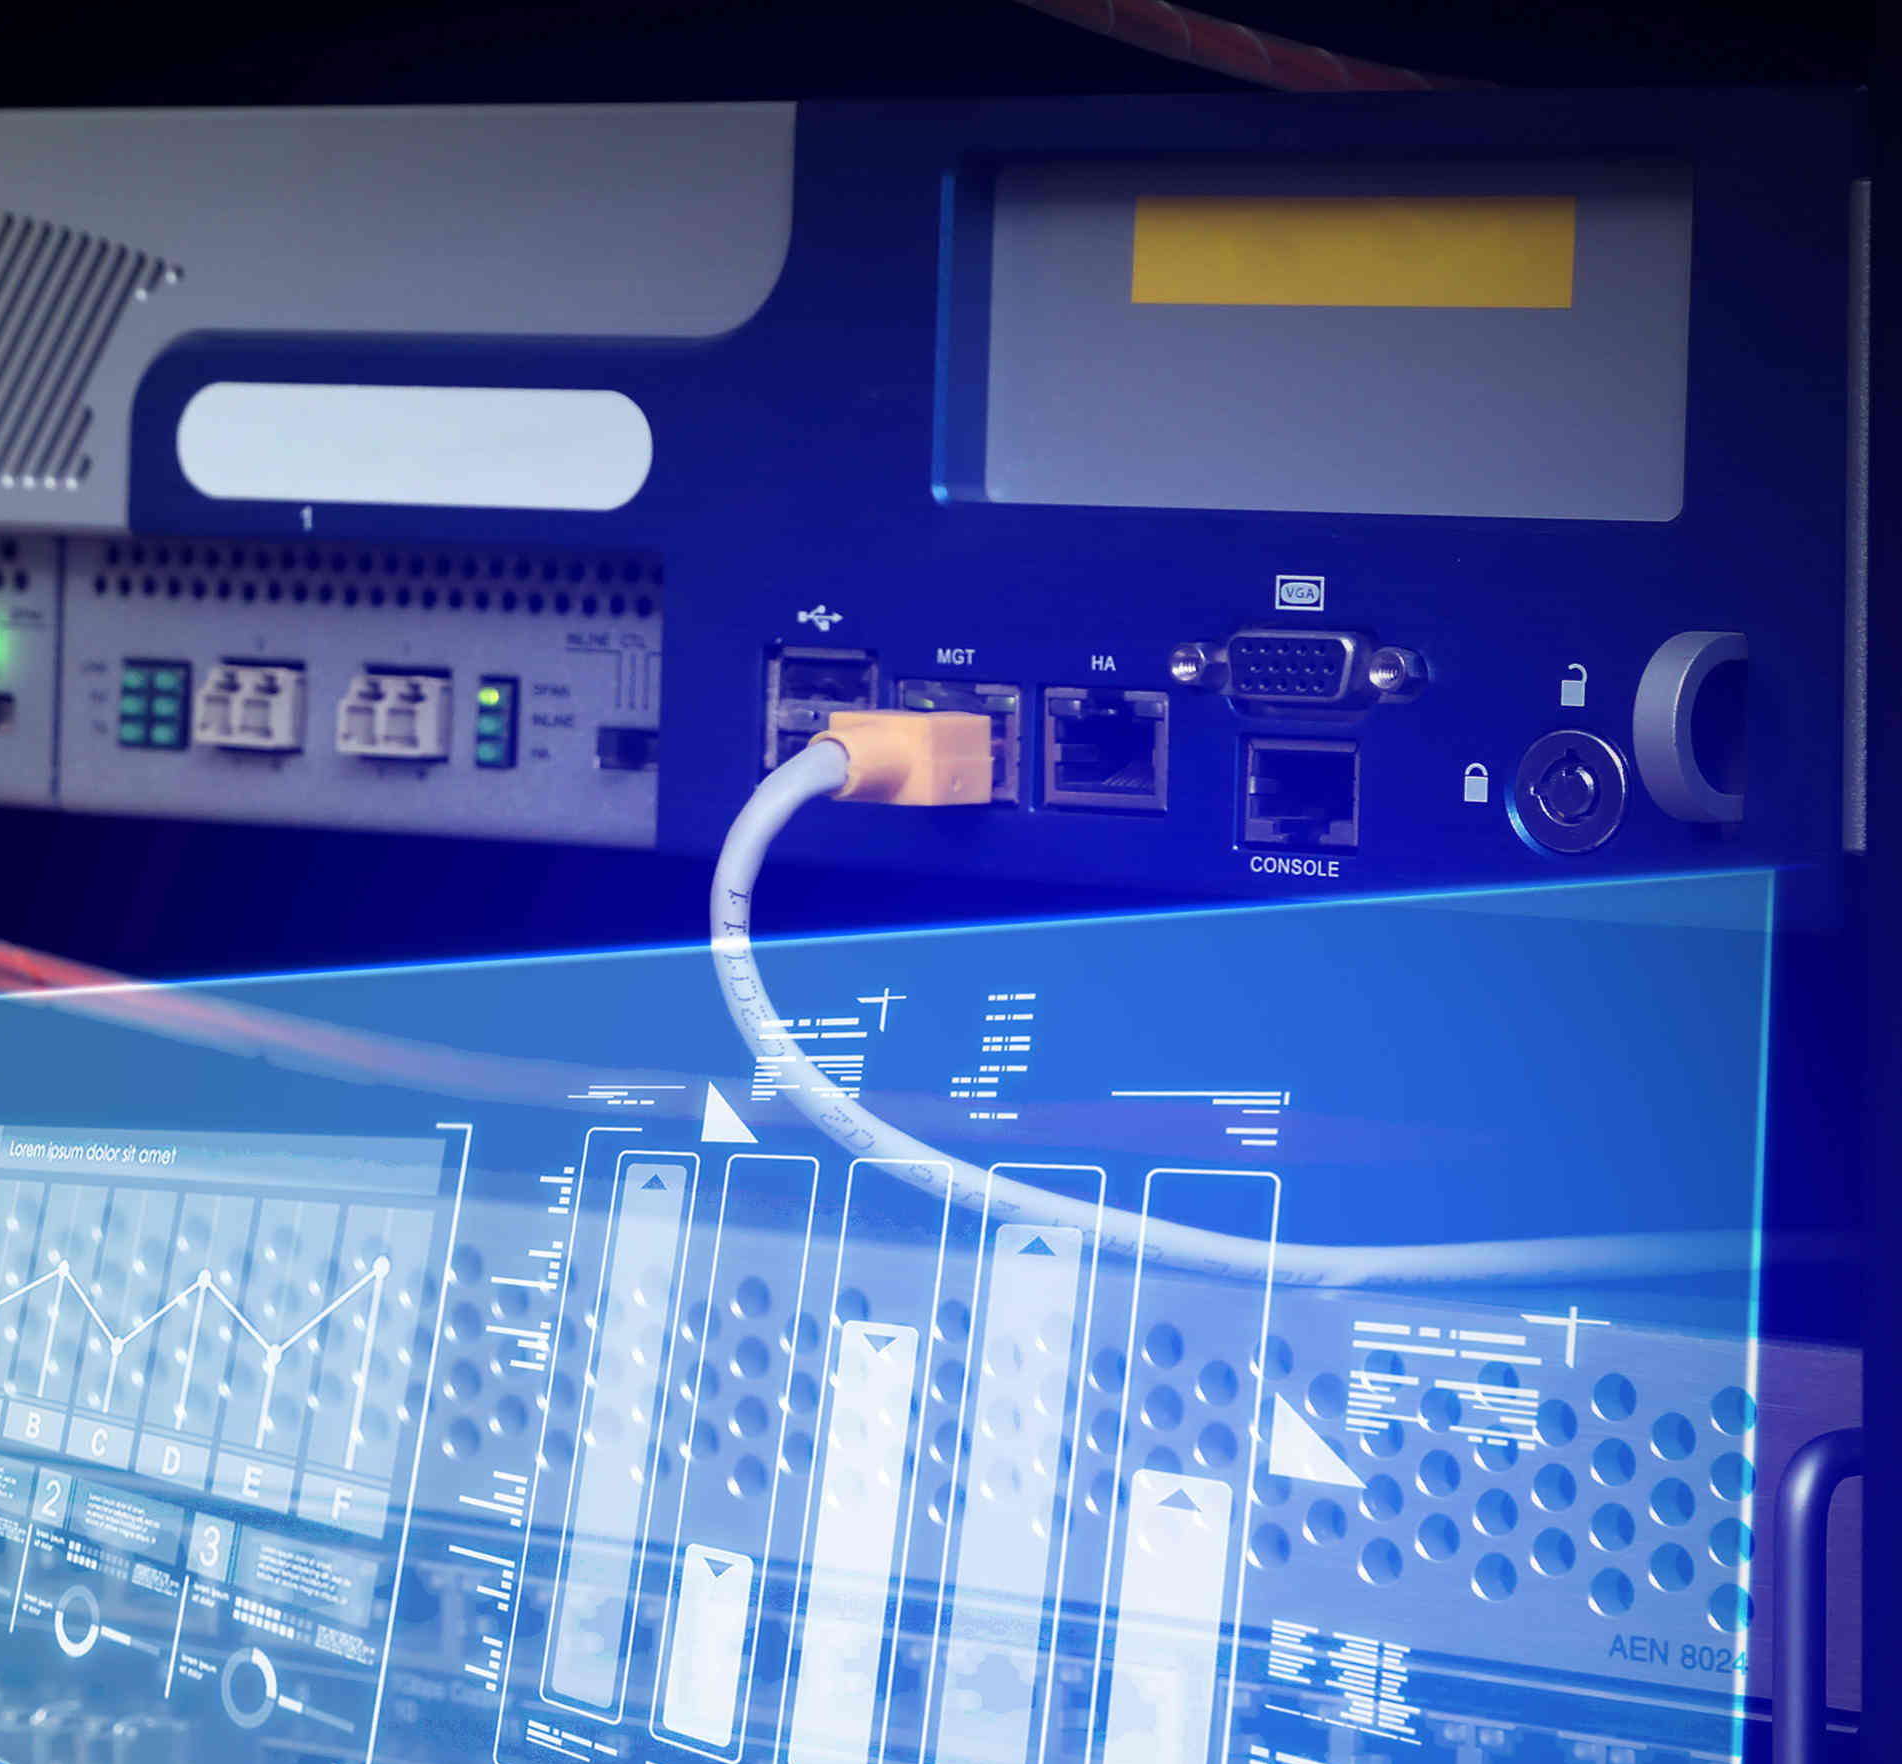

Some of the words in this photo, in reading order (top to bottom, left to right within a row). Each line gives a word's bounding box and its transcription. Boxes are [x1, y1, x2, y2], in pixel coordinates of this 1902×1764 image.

[1285, 586, 1315, 600] VGA
[937, 648, 975, 665] MGT
[1091, 655, 1116, 672] HA
[1250, 856, 1340, 878] CONSOLE
[9, 1139, 45, 1159] Lorem
[47, 1142, 84, 1161] ipsum
[85, 1143, 120, 1161] dolor
[122, 1144, 136, 1162] sit
[138, 1146, 177, 1166] amet
[24, 1412, 42, 1439] B
[91, 1428, 108, 1458] C
[161, 1445, 182, 1476] D
[241, 1465, 264, 1499] E
[331, 1487, 354, 1521] F
[42, 1479, 62, 1518] 2
[199, 1525, 221, 1567] 3
[1609, 1633, 1669, 1666] AEN
[1681, 1643, 1749, 1676] 8024
